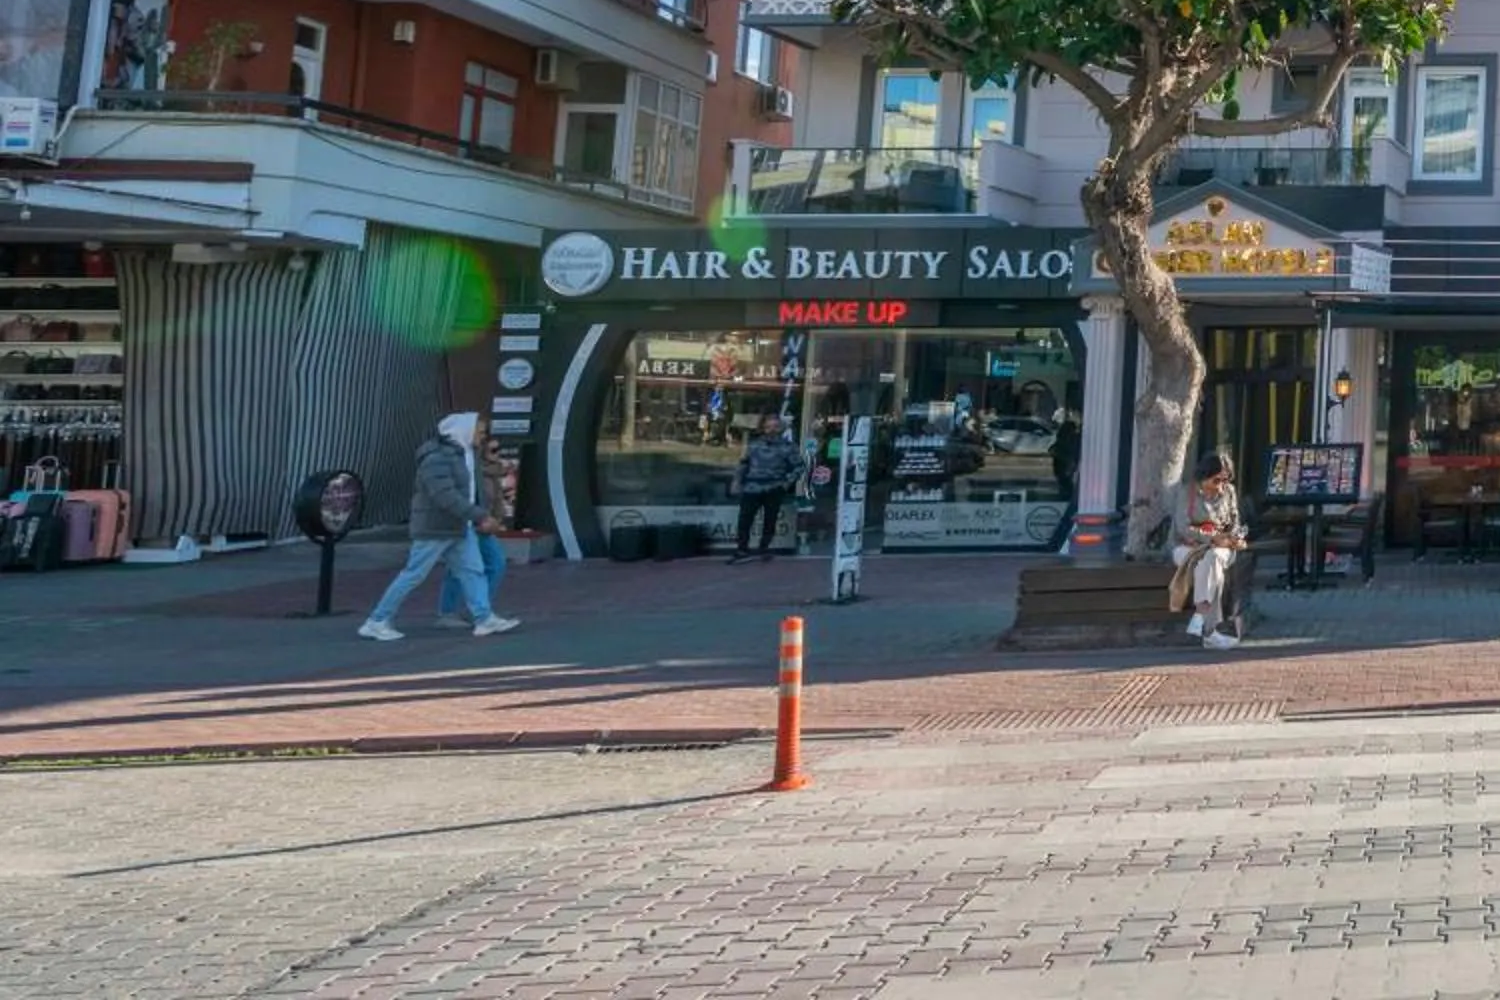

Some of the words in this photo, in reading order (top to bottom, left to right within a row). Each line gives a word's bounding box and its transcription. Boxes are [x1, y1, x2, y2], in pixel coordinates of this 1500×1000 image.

[620, 247, 730, 279] HAIR
[741, 246, 776, 279] &
[787, 247, 946, 280] BEAUTY
[967, 246, 1073, 279] SALO
[779, 302, 859, 324] MAKE
[867, 302, 907, 324] UP
